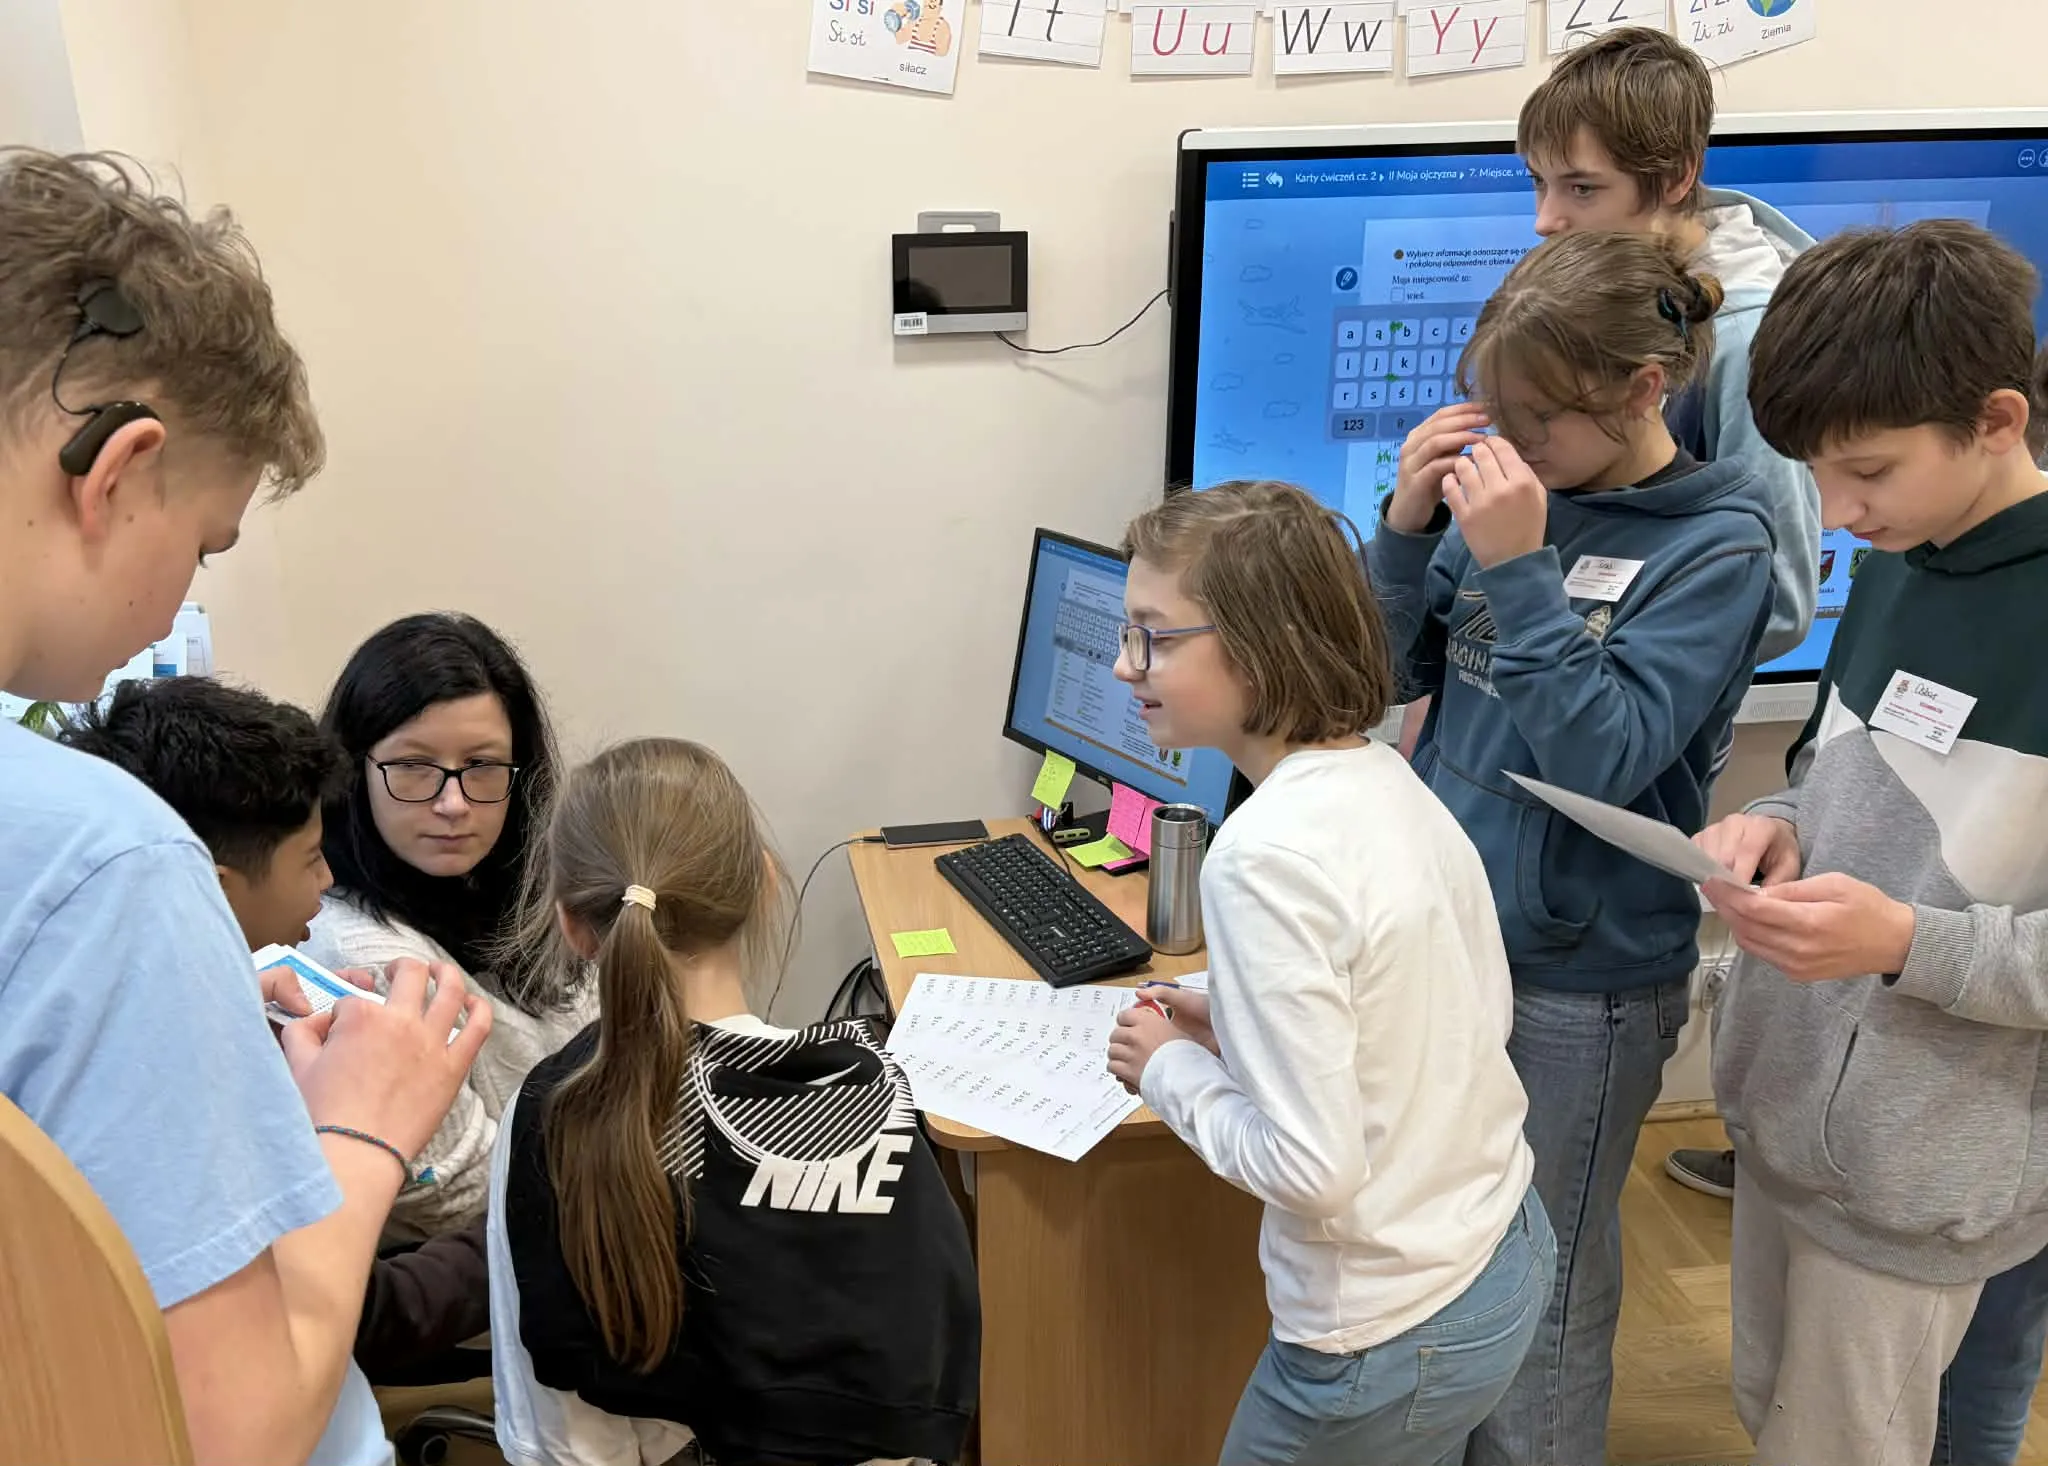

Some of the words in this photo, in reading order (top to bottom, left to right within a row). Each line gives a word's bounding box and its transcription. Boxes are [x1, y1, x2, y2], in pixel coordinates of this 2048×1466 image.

[828, 19, 847, 43] Si
[1152, 8, 1187, 56] U
[1202, 22, 1231, 56] u
[1282, 7, 1332, 55] W
[1344, 19, 1382, 53] w
[1430, 7, 1461, 54] Y
[1471, 16, 1499, 64] y
[1761, 24, 1792, 40] Ziemia
[1295, 173, 1319, 184] Karty
[1370, 171, 1377, 181] 2
[1396, 170, 1418, 182] Moja
[1420, 170, 1457, 181] ojczyzna
[1346, 331, 1354, 339] a
[1404, 326, 1411, 337] b
[1432, 327, 1439, 337] c
[1401, 357, 1409, 369] k
[1343, 392, 1349, 401] r
[1370, 391, 1377, 400] s
[1427, 387, 1433, 398] t
[1343, 419, 1364, 431] 123
[740, 1133, 914, 1214] NIKE
